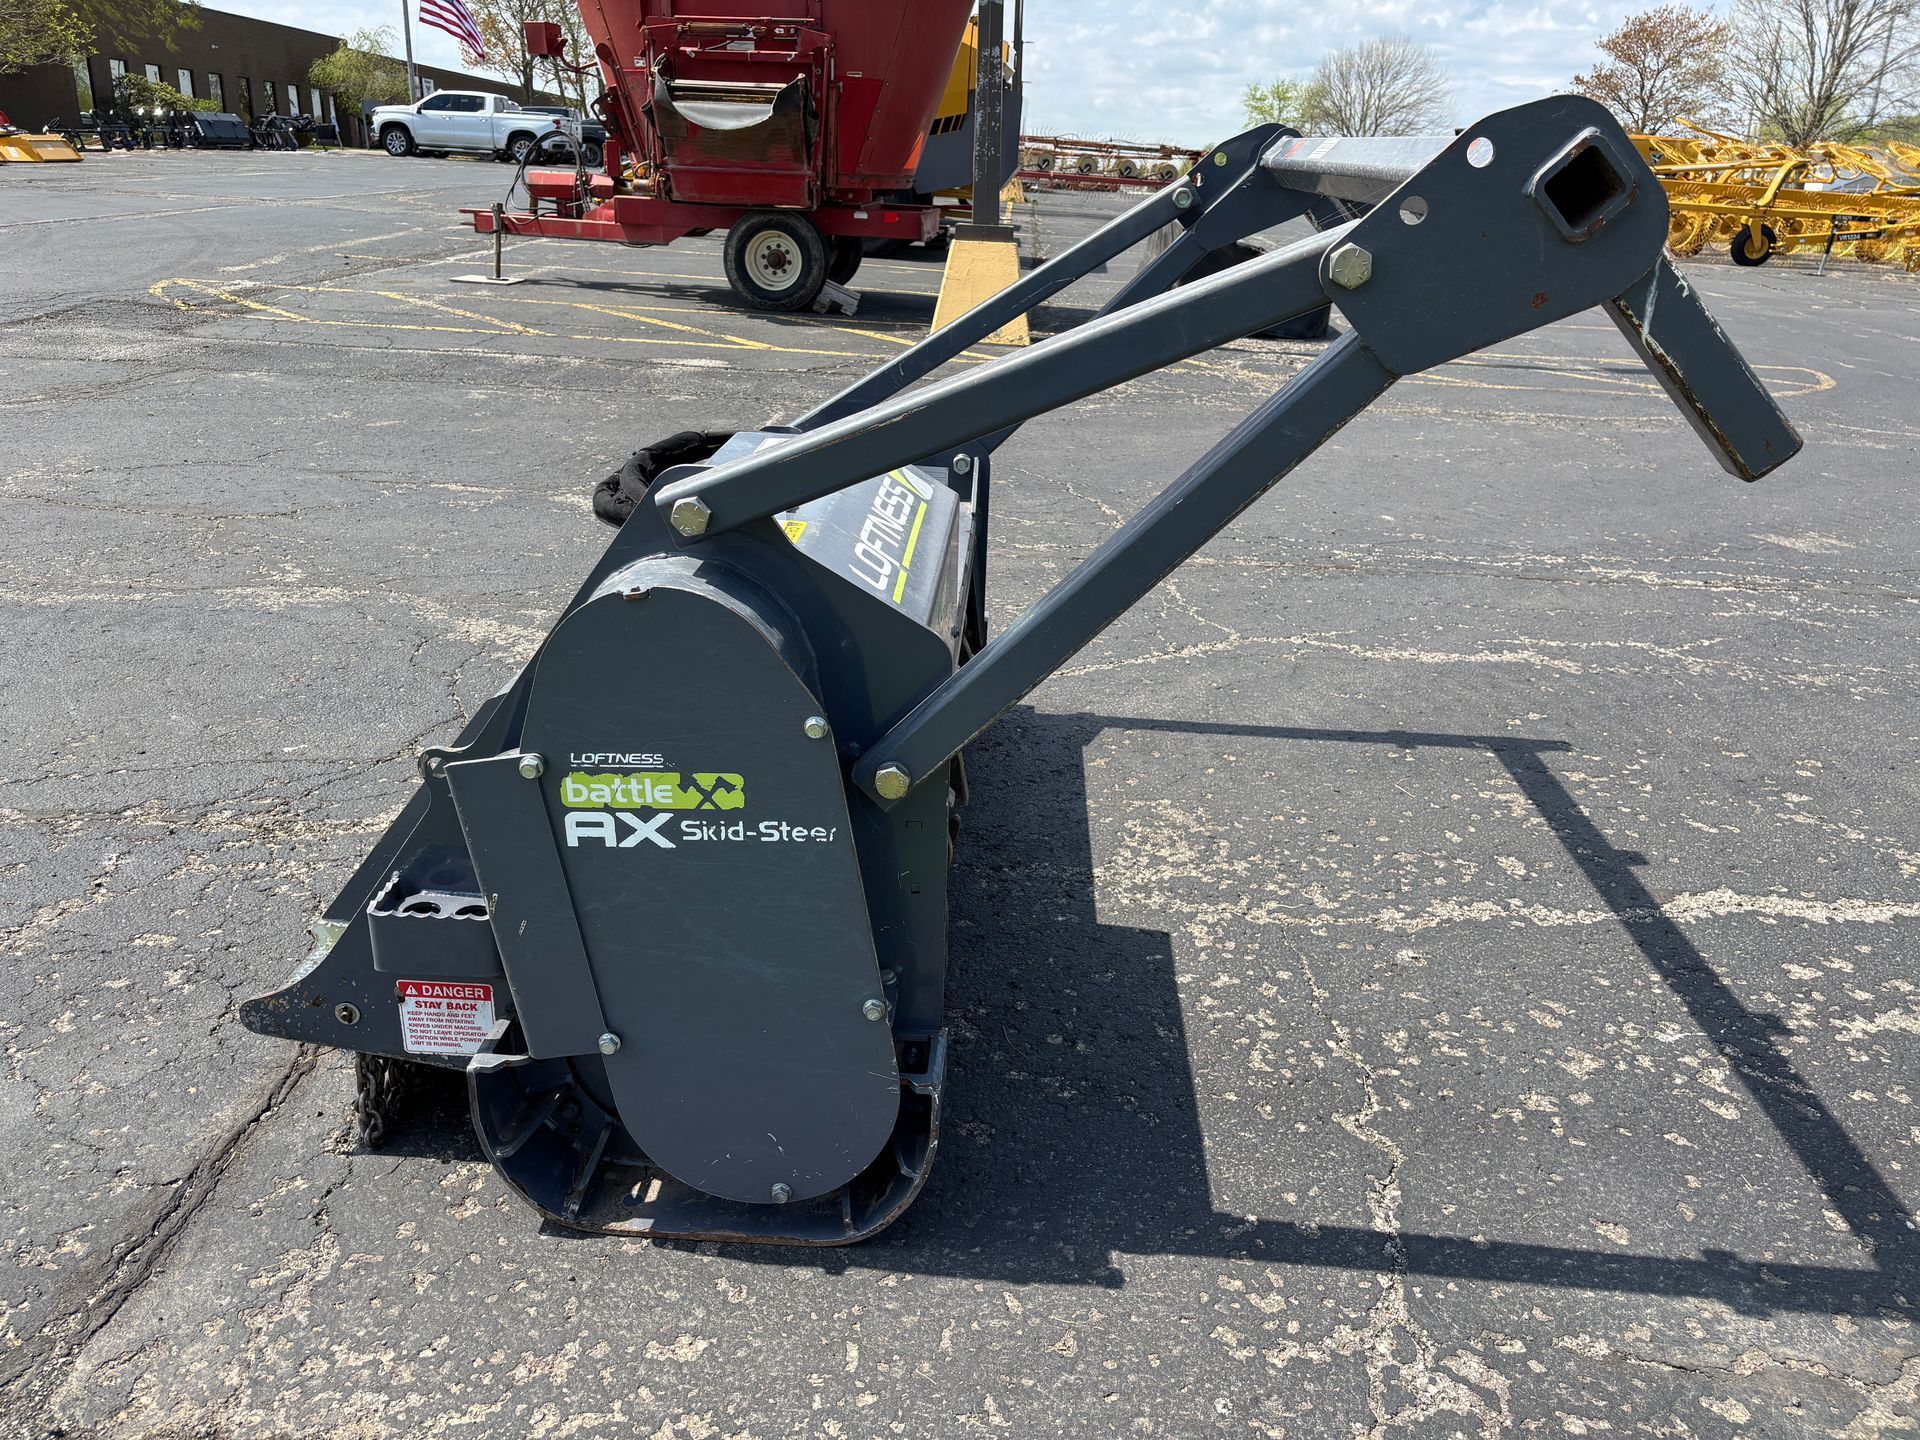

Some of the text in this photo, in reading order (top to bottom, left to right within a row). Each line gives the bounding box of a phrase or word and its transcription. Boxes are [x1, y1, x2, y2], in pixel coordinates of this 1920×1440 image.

[848, 476, 915, 591] LOFTNESS
[570, 753, 664, 764] LOFTNESS
[565, 777, 674, 804] battle
[564, 811, 677, 849] AX
[680, 820, 837, 842] Skid-Steer
[422, 986, 484, 999] DANGER
[415, 1001, 478, 1011] STAY BACK
